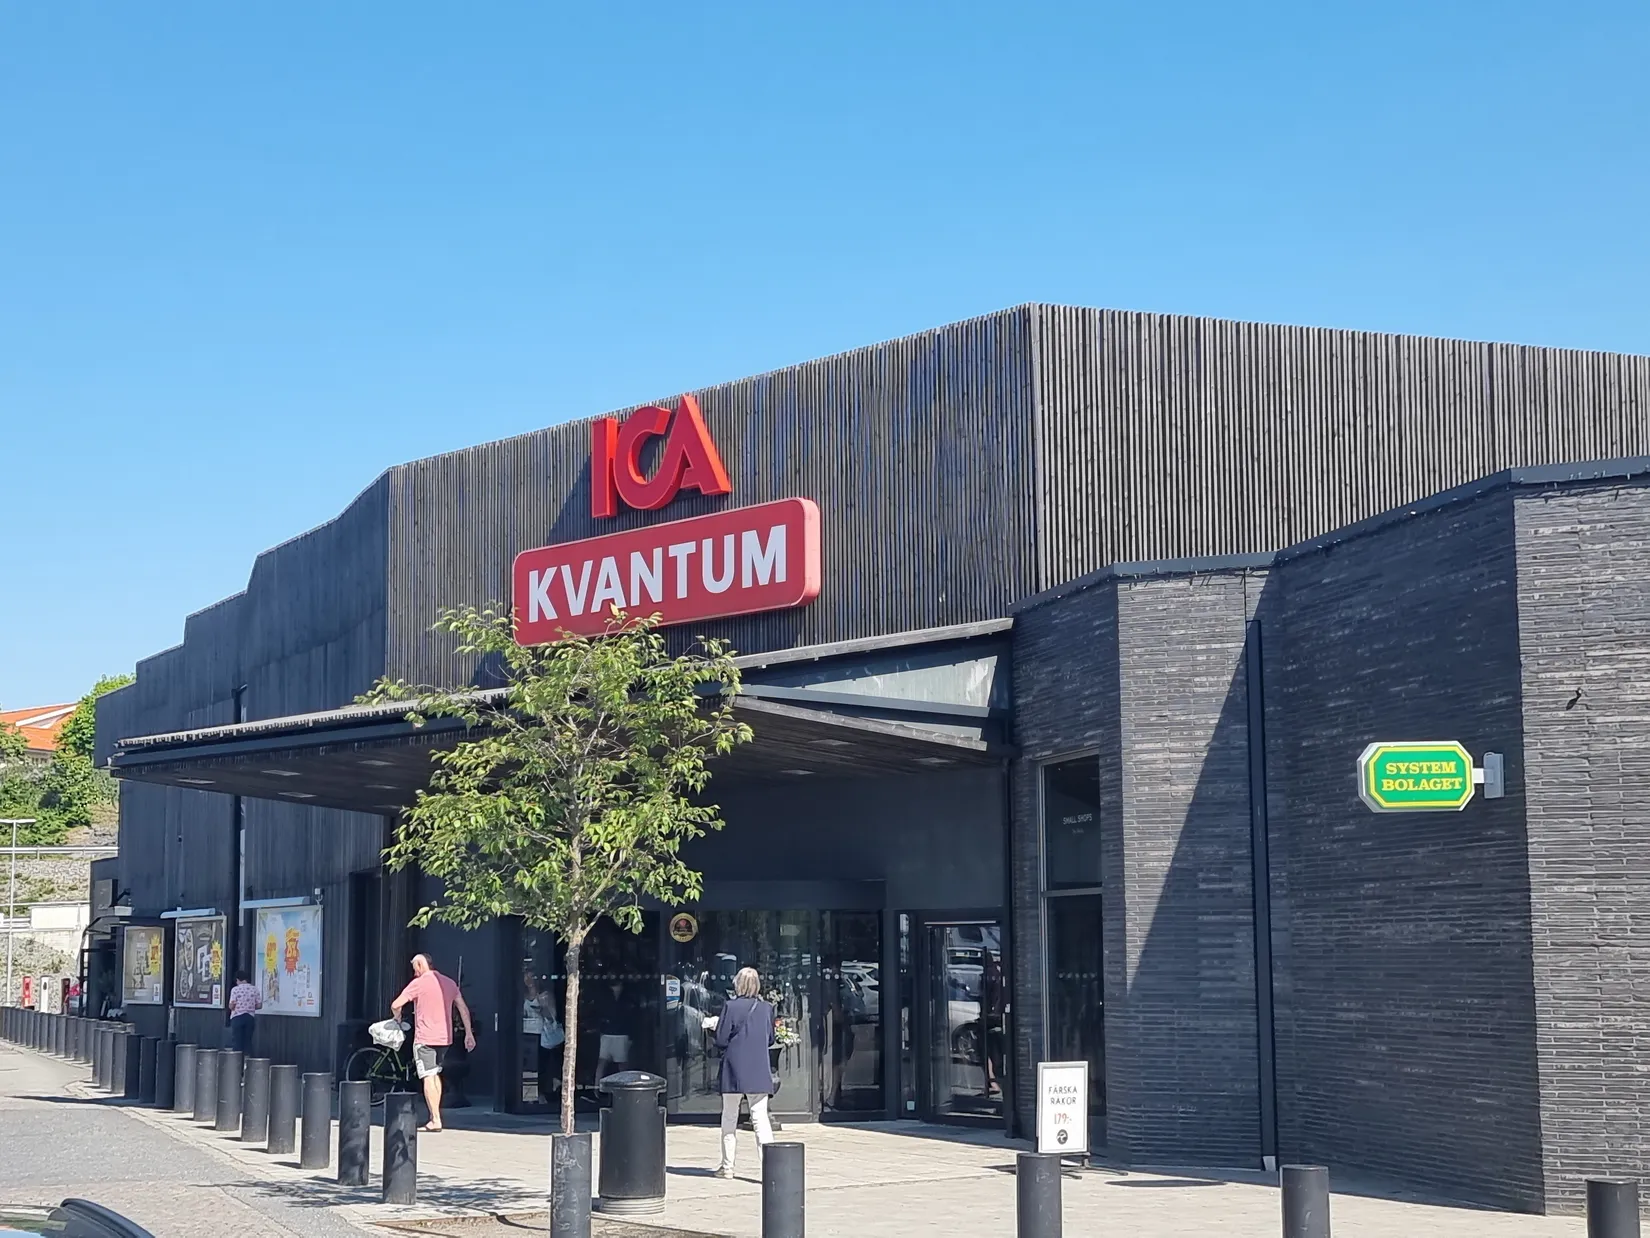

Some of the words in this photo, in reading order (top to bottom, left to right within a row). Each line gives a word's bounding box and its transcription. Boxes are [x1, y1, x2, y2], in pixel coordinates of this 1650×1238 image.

[592, 393, 732, 518] ICA
[528, 524, 787, 623] KVANTUM
[1382, 777, 1463, 791] BOLAGET
[1386, 761, 1457, 775] SYSTEM
